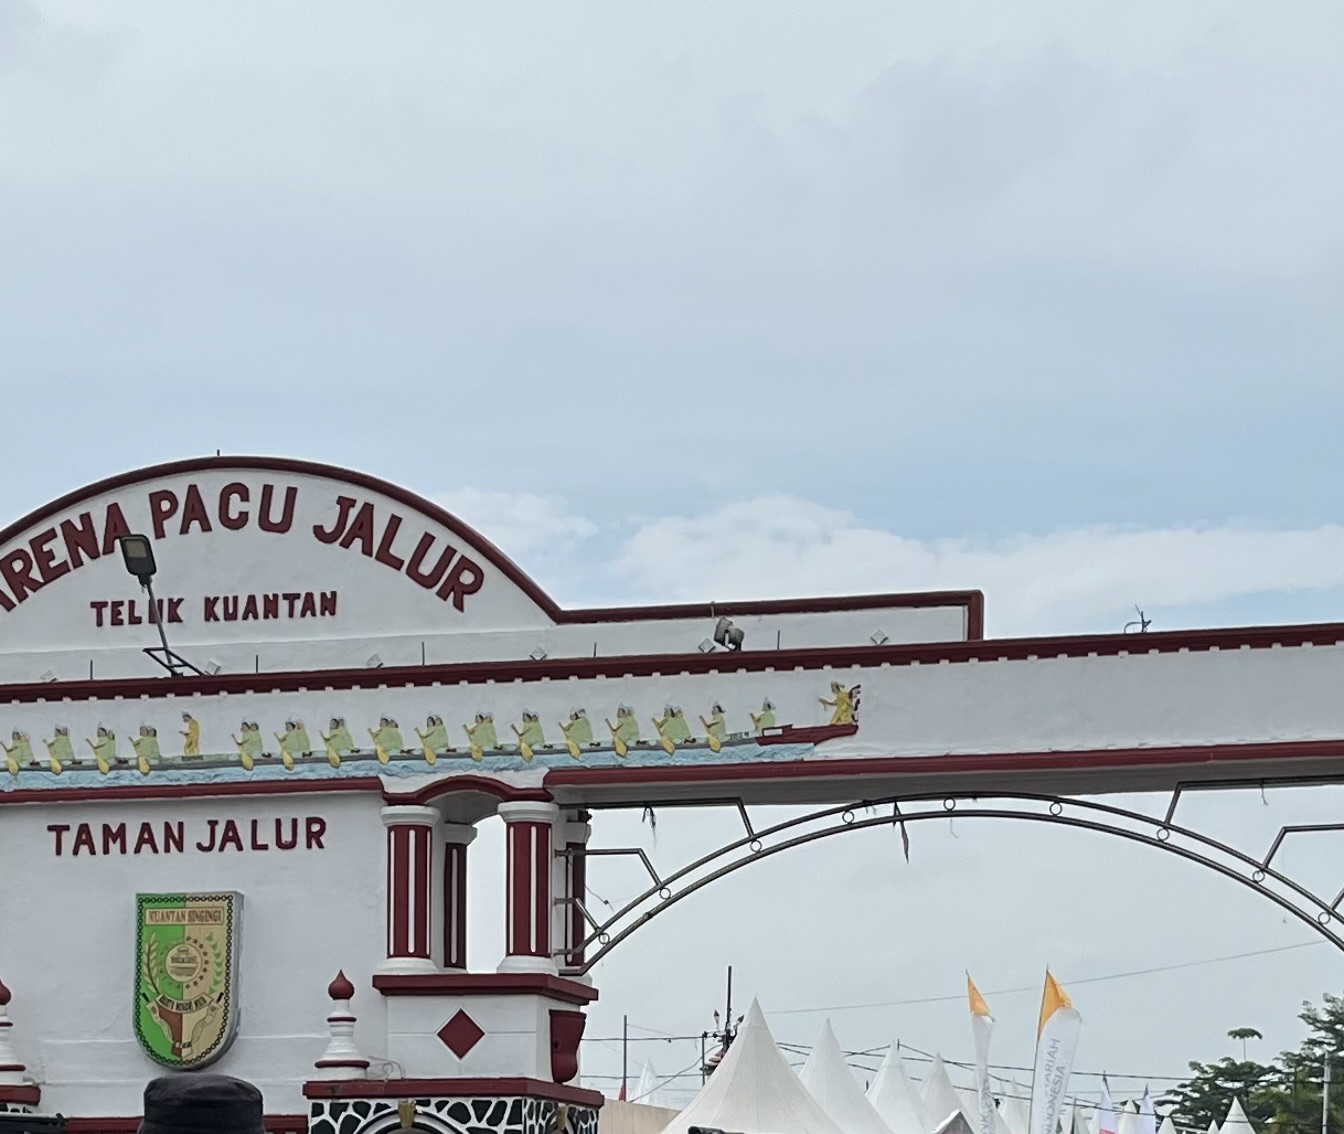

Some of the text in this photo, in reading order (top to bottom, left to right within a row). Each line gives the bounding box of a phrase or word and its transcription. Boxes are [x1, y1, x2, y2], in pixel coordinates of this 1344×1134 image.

[148, 482, 298, 540] PACU
[313, 495, 484, 613] JALUR
[90, 591, 337, 628] TELUK KUANTAN
[47, 817, 327, 856] TAMAN JALUR
